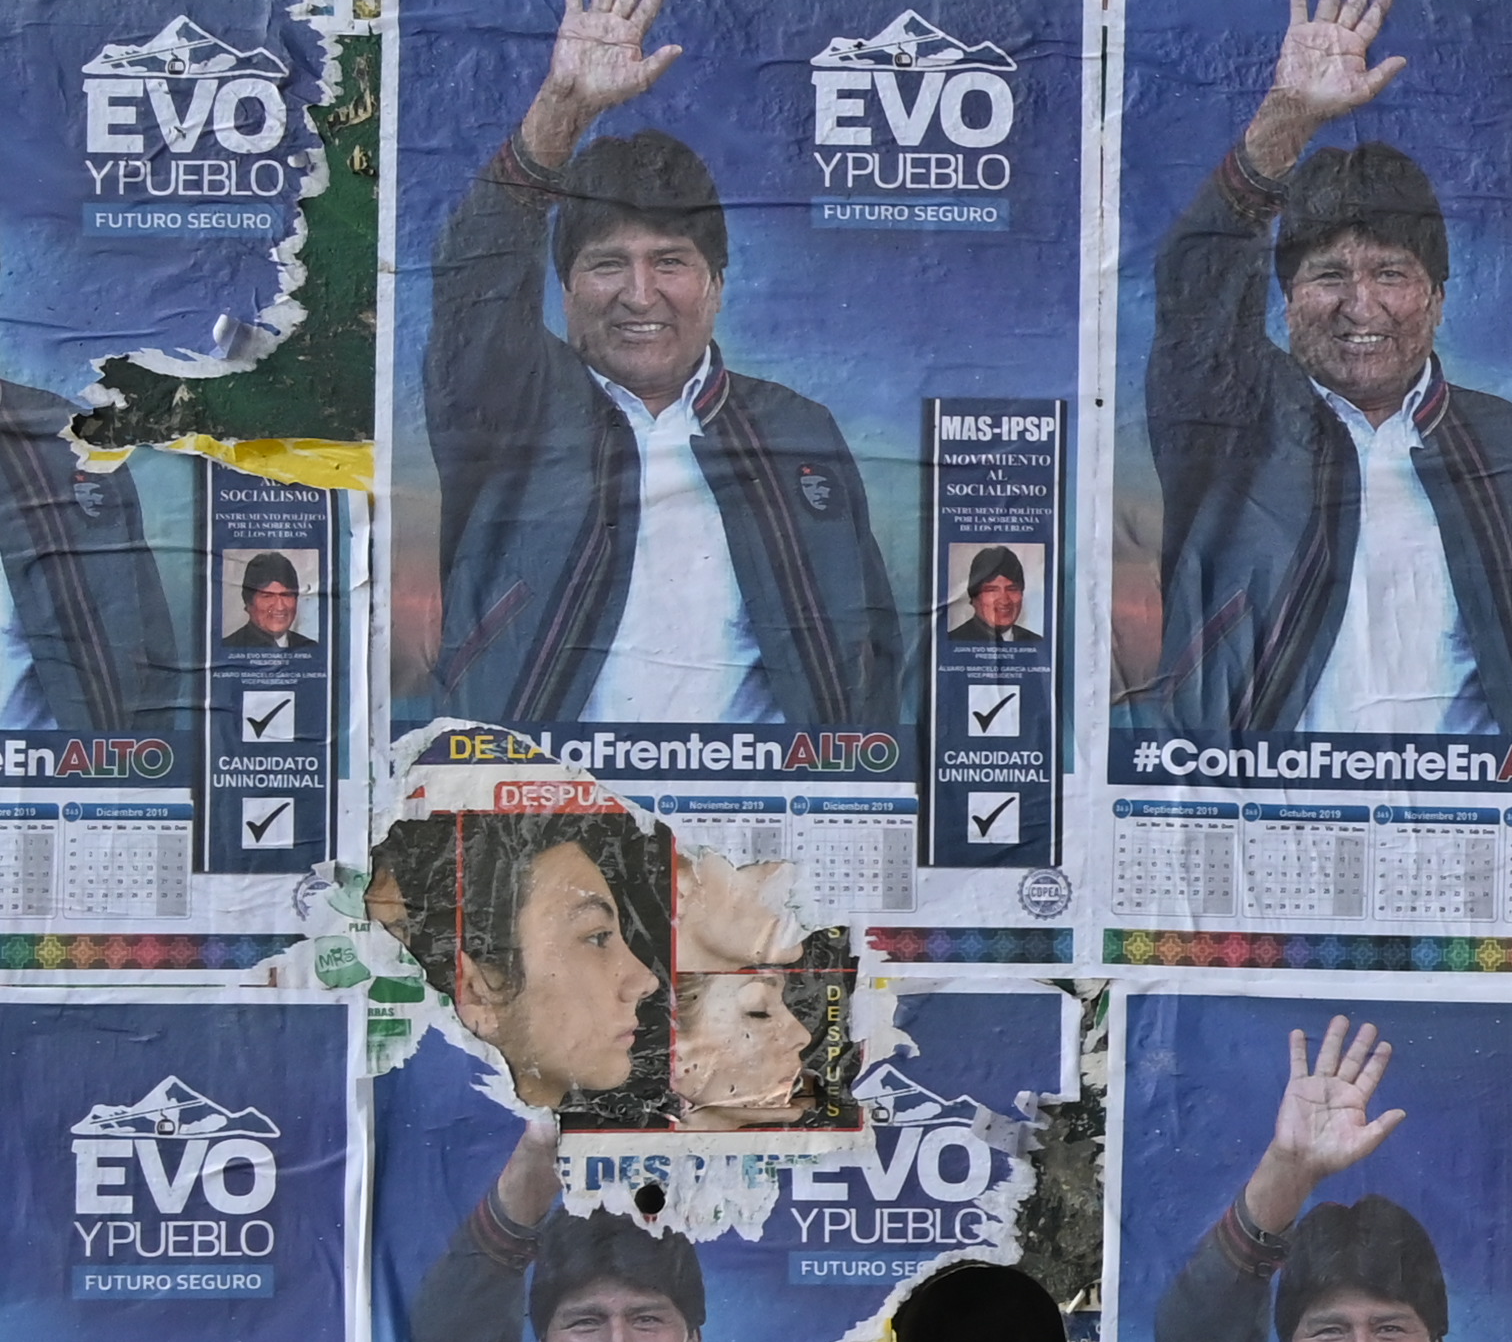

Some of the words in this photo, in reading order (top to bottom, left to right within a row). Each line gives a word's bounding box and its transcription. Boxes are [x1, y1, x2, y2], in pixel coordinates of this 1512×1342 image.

[83, 78, 286, 154] EVO
[811, 71, 1013, 147] EVO
[0, 739, 173, 779] EnALTO
[71, 1138, 277, 1215] EVO
[84, 1276, 170, 1291] FUTURO
[176, 1275, 261, 1289] SEGURO
